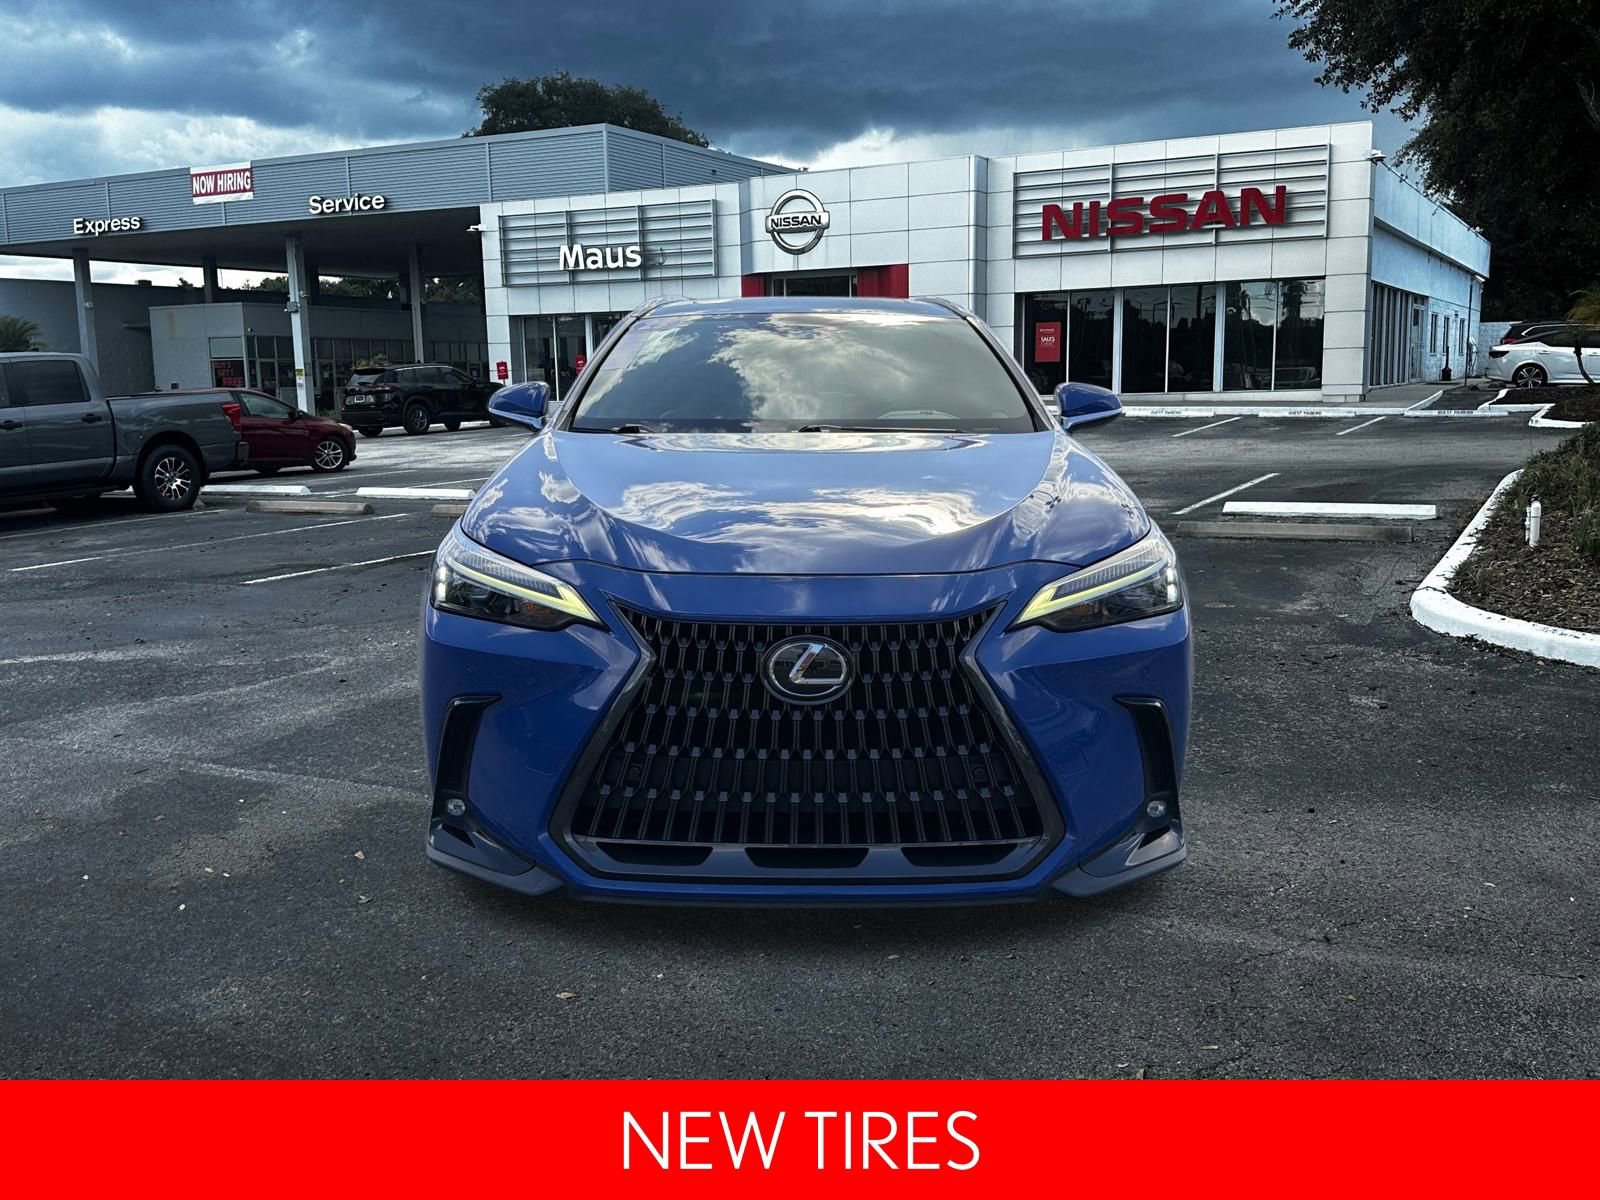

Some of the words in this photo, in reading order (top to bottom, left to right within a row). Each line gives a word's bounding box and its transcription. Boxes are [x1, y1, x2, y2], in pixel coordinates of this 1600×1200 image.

[193, 174, 216, 195] NOW
[217, 171, 251, 193] HIRING
[308, 192, 385, 215] Service
[1042, 185, 1287, 241] NISSAN
[73, 216, 141, 237] Express
[770, 214, 822, 229] NISSAN
[559, 243, 642, 271] Maus
